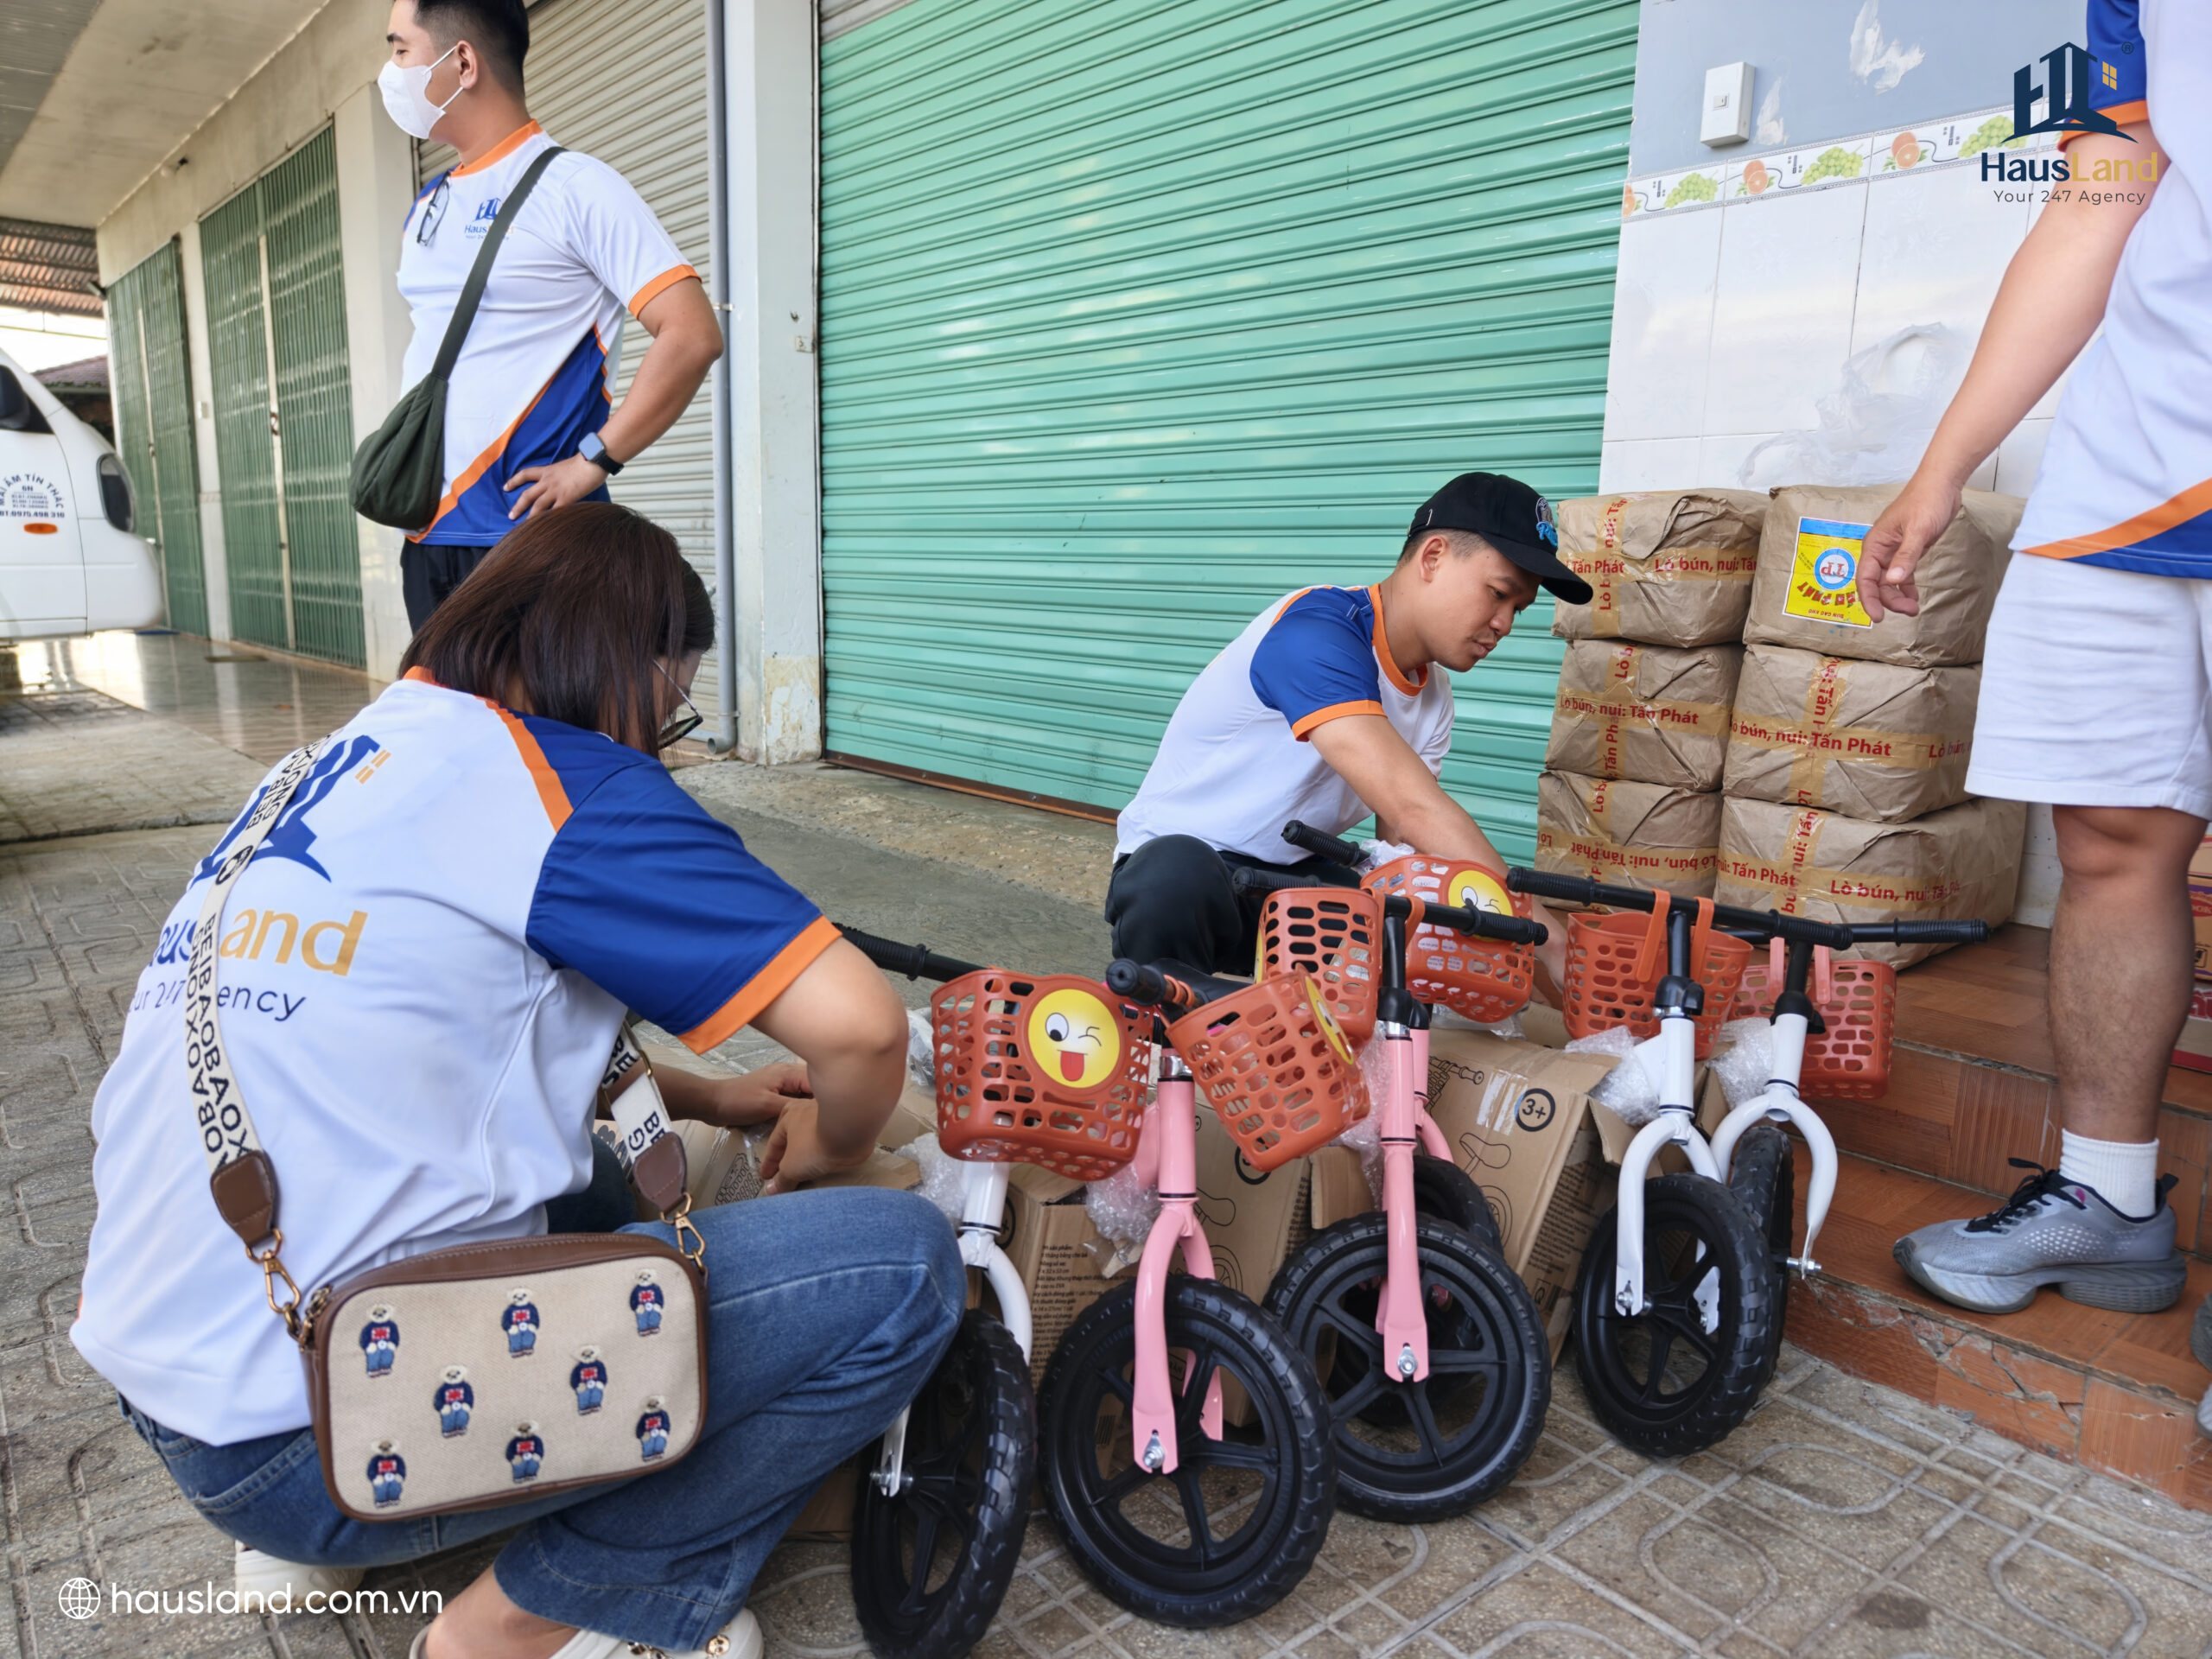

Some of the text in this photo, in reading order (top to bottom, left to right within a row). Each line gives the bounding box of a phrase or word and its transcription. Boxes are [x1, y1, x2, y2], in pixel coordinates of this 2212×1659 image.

[1595, 560, 1624, 574] Phát
[1655, 558, 1675, 572] Lò
[1679, 556, 1713, 572] bún,
[1599, 703, 1626, 717] nui:
[1660, 709, 1700, 725] Phát
[1847, 738, 1892, 756] Phát
[1732, 861, 1757, 880] Tấn
[1760, 868, 1796, 887] Phát
[1830, 880, 1853, 895] Lò
[1857, 883, 1900, 902] bún,
[1522, 1098, 1547, 1120] 3+
